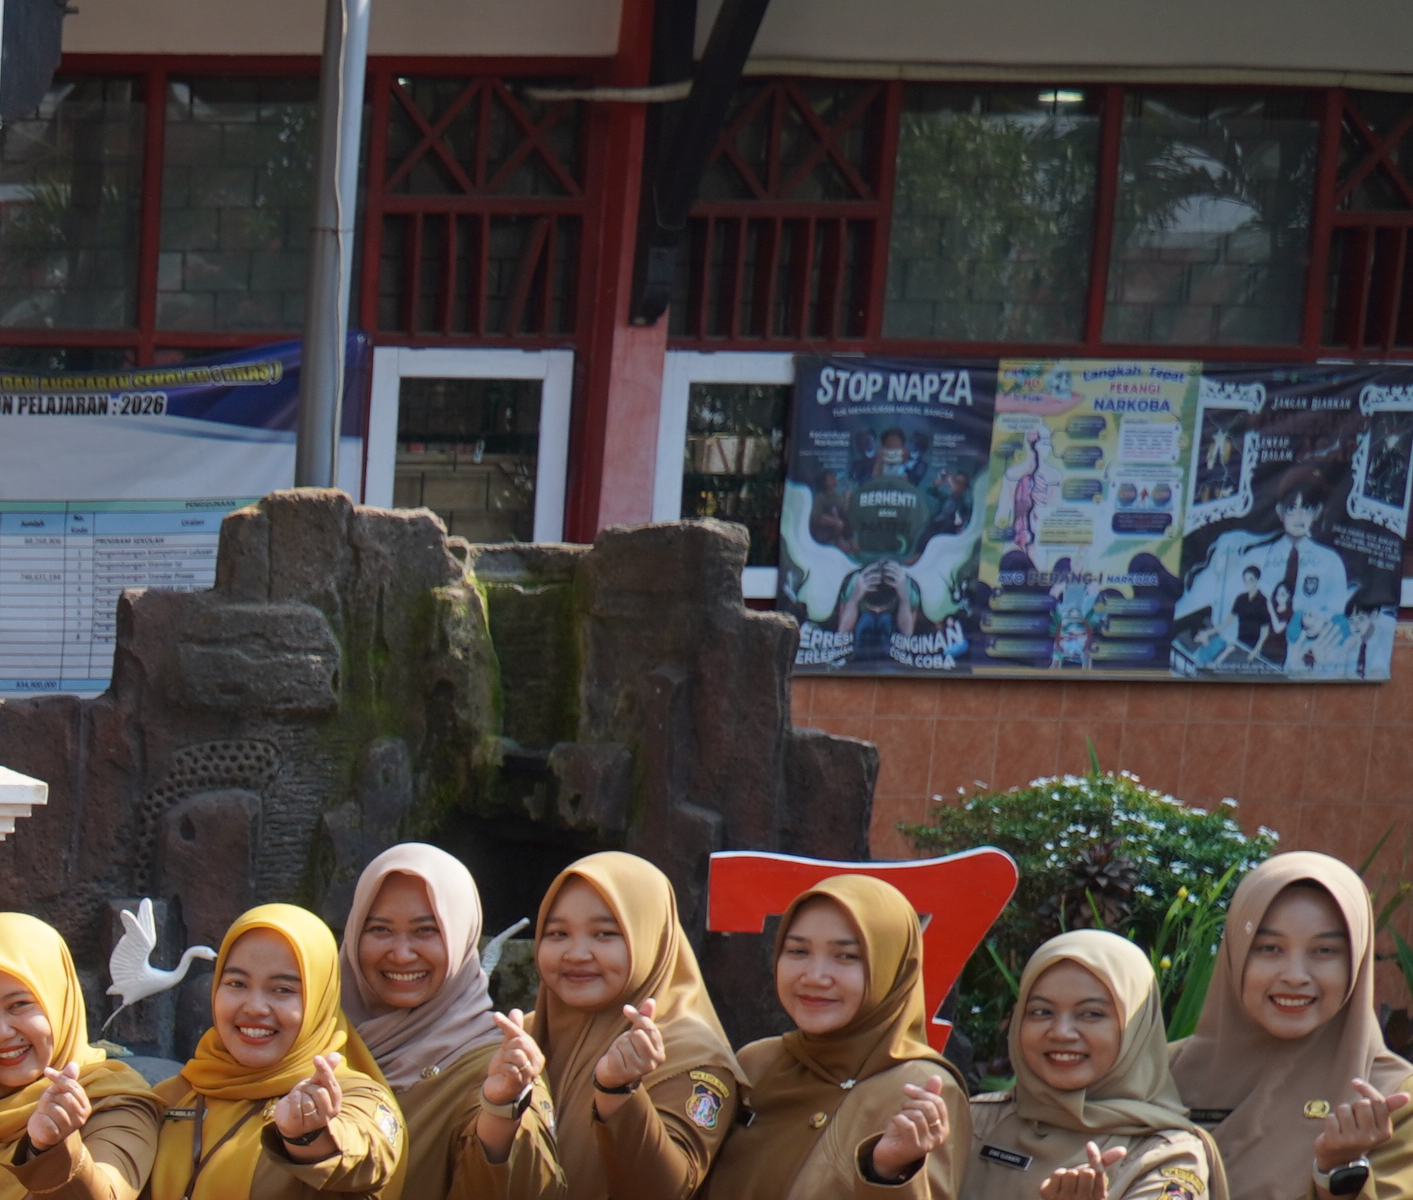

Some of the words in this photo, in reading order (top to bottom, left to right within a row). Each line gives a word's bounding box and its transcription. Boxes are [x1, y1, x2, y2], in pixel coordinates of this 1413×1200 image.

[132, 370, 210, 388] SEKOLAH
[1083, 365, 1142, 382] Langkah
[1149, 365, 1185, 384] Tepat
[816, 366, 883, 405] STOP
[886, 369, 973, 406] NAPZA
[1109, 382, 1162, 394] PERANGI
[18, 396, 108, 416] PELAJARAN
[119, 395, 164, 415] 2026
[1093, 398, 1171, 413] NARKOBA
[859, 490, 917, 508] BERHENTI
[800, 622, 854, 648] EPRESI
[795, 645, 854, 665] ERLEBIHAN
[914, 653, 957, 670] COBA
